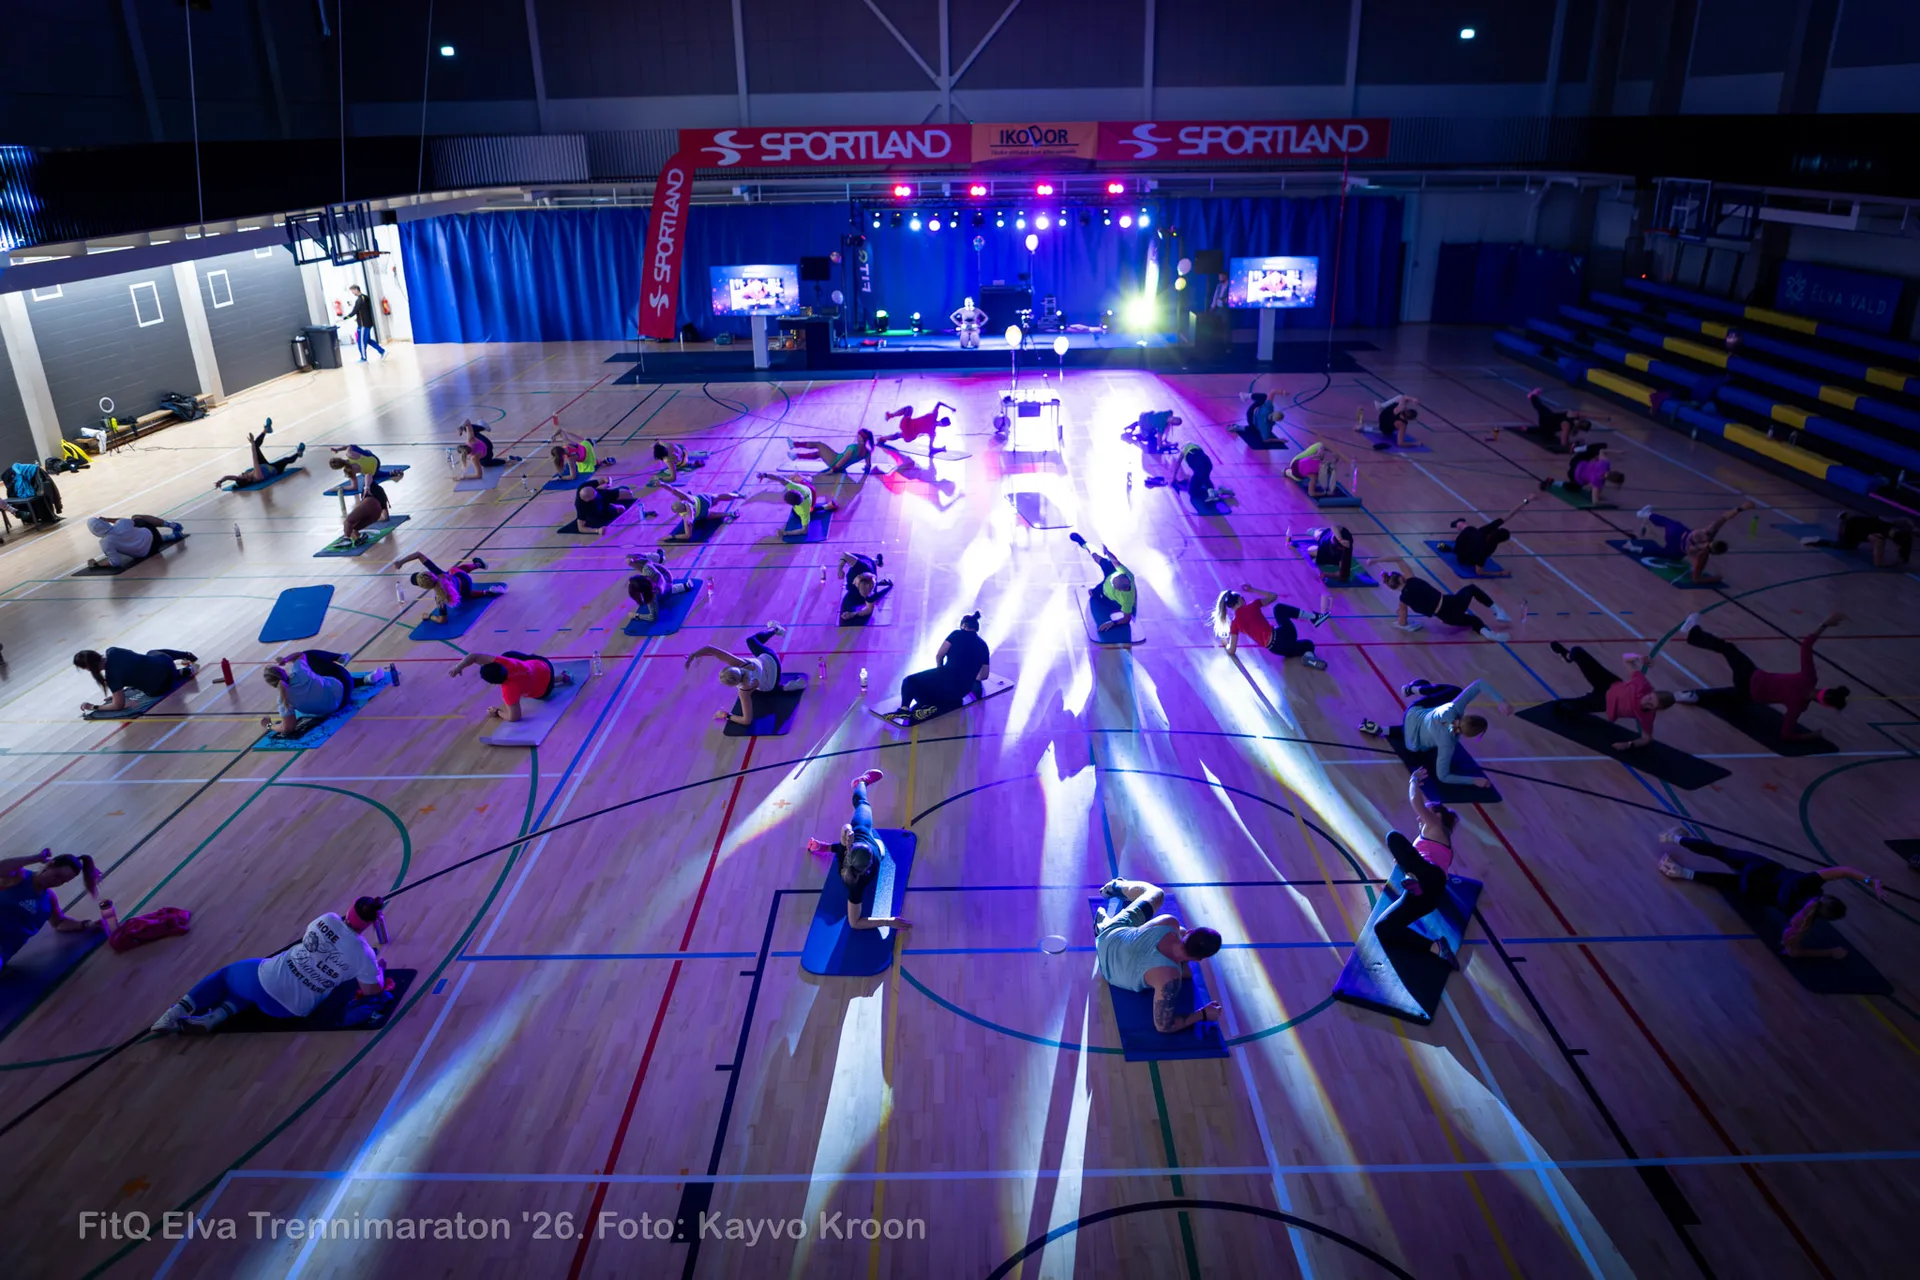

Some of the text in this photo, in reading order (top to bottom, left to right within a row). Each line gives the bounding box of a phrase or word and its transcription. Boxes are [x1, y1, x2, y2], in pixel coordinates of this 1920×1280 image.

[760, 129, 952, 161] SPORTLAND
[1000, 125, 1068, 148] IKODOR
[1178, 124, 1369, 156] SPORTLAND
[654, 168, 685, 284] SPORTLAND
[1810, 283, 1887, 315] ELVA VALD
[317, 920, 340, 944] MORE
[316, 960, 340, 979] LESS
